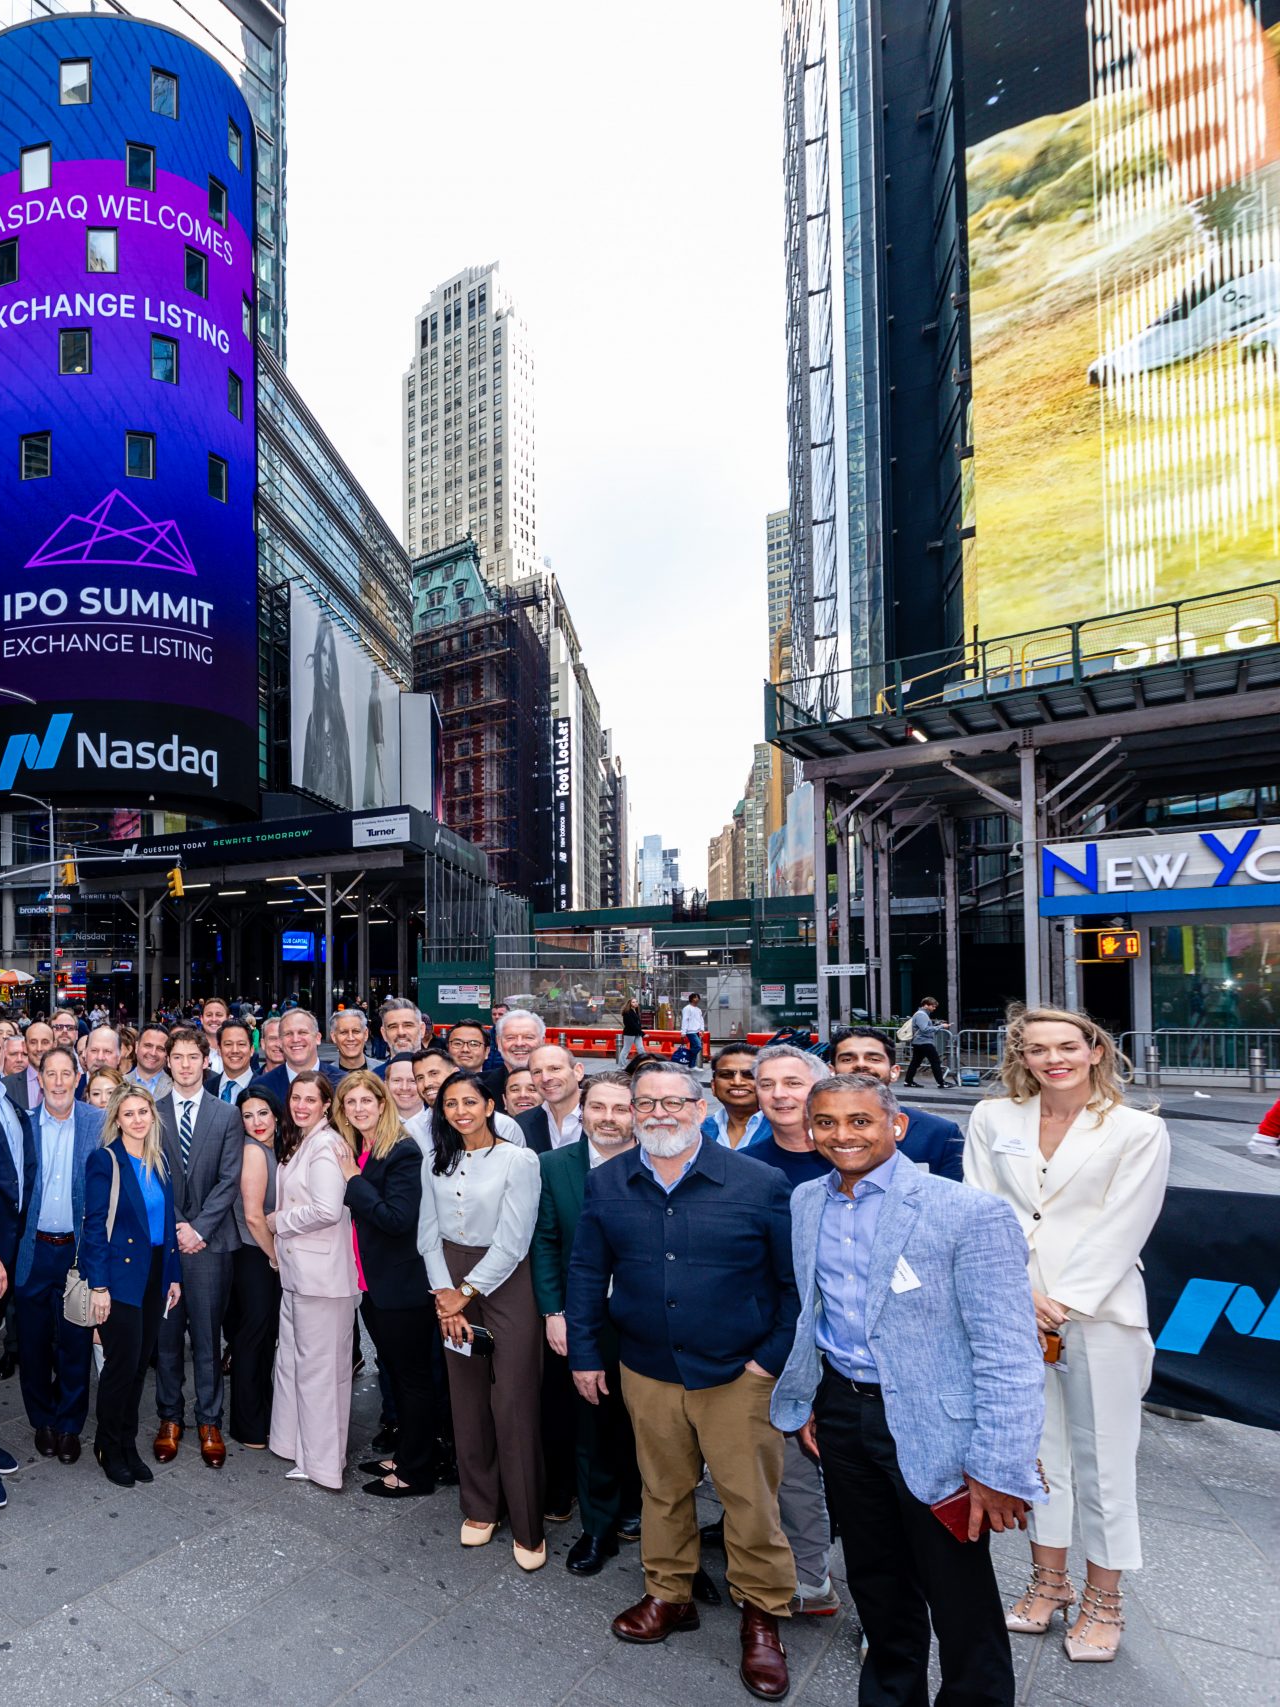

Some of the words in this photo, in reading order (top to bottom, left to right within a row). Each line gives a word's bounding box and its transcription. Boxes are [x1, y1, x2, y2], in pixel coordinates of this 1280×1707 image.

[97, 194, 233, 266] WELCOMES
[144, 297, 230, 354] LISTING
[3, 588, 68, 621] IPO
[79, 587, 214, 628] SUMMIT
[3, 633, 134, 658] EXCHANGE
[141, 635, 213, 664] LISTING
[76, 732, 218, 788] Nasdaq
[555, 721, 570, 764] Locker
[555, 767, 570, 797] Foot
[143, 844, 180, 854] QUESTION
[182, 841, 207, 850] TODAY
[213, 836, 252, 847] REWRITE
[366, 828, 395, 837] Turner
[1042, 843, 1188, 897] NEW
